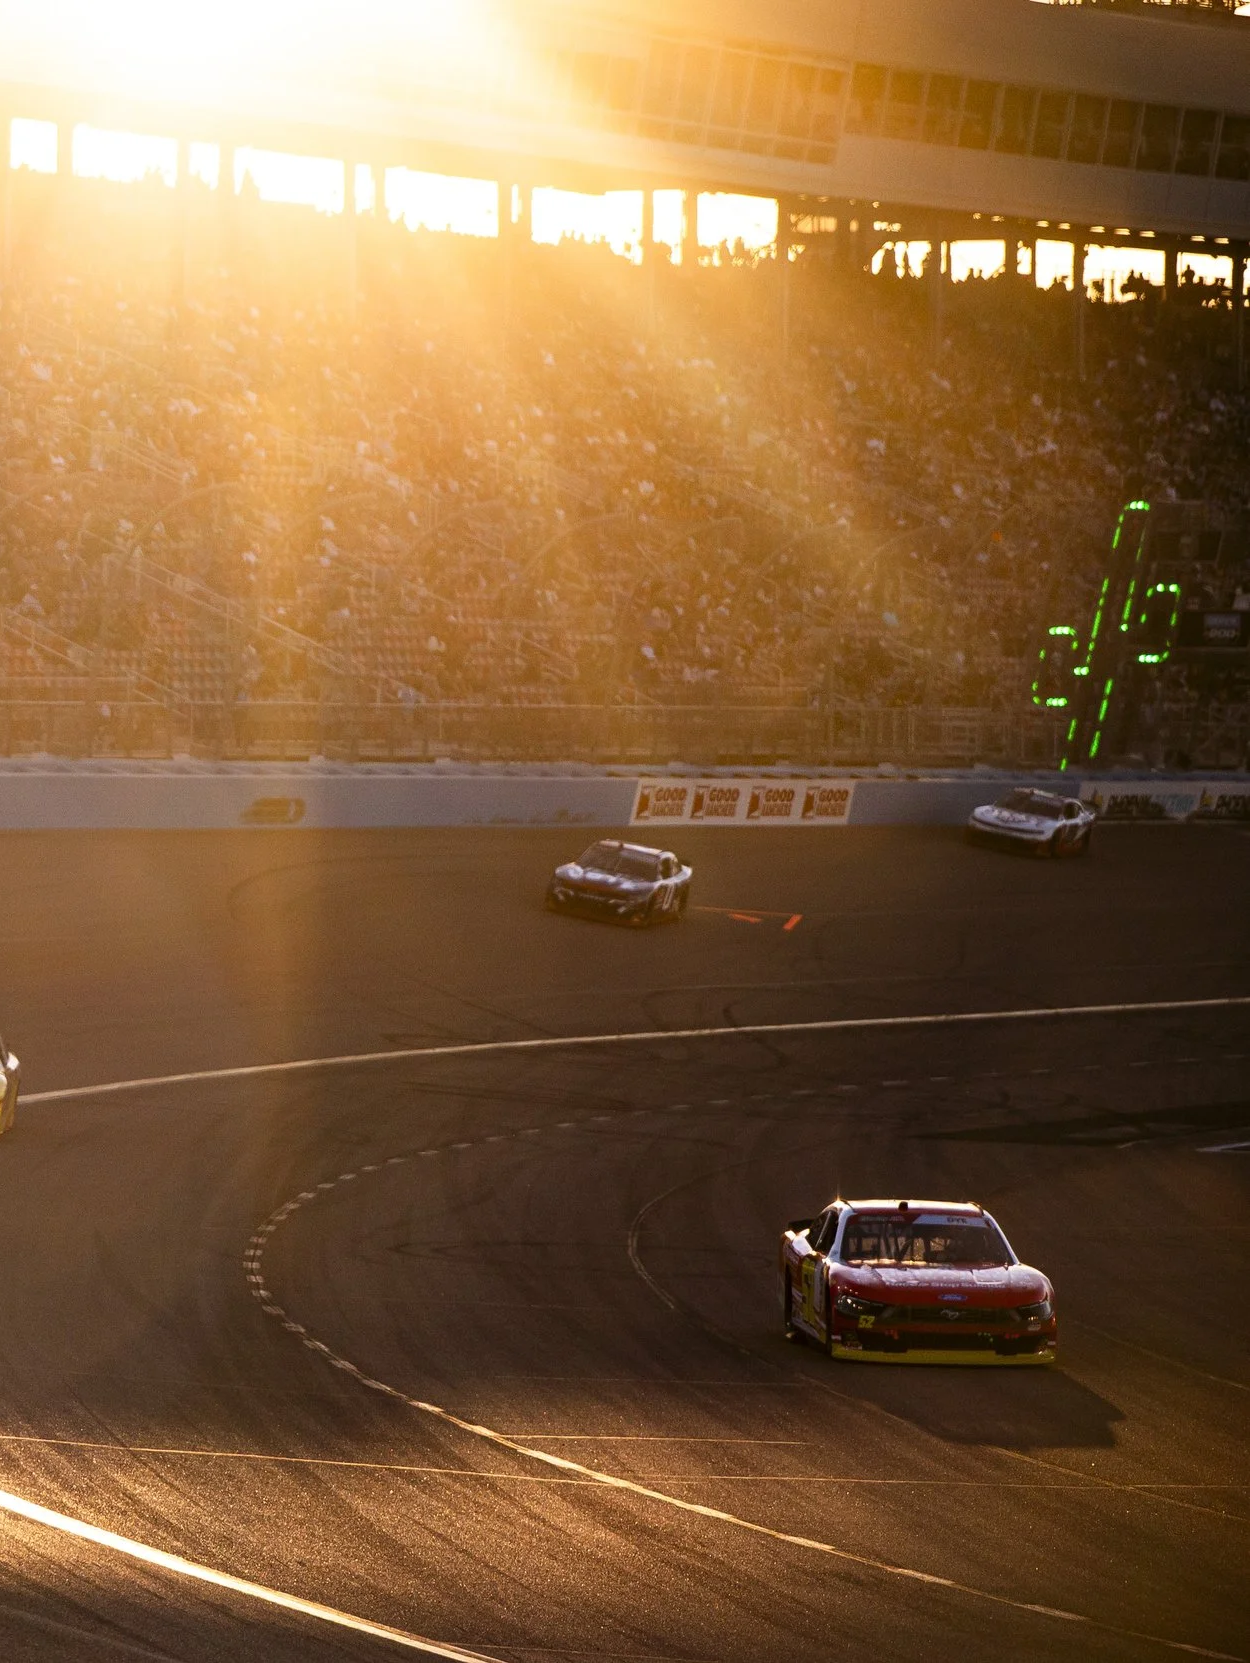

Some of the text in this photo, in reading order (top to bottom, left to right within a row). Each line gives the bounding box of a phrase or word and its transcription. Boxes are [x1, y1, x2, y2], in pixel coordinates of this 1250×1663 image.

[655, 787, 687, 802] GOOD
[709, 787, 740, 802] GOOD
[764, 787, 795, 802] GOOD
[818, 787, 849, 802] GOOD
